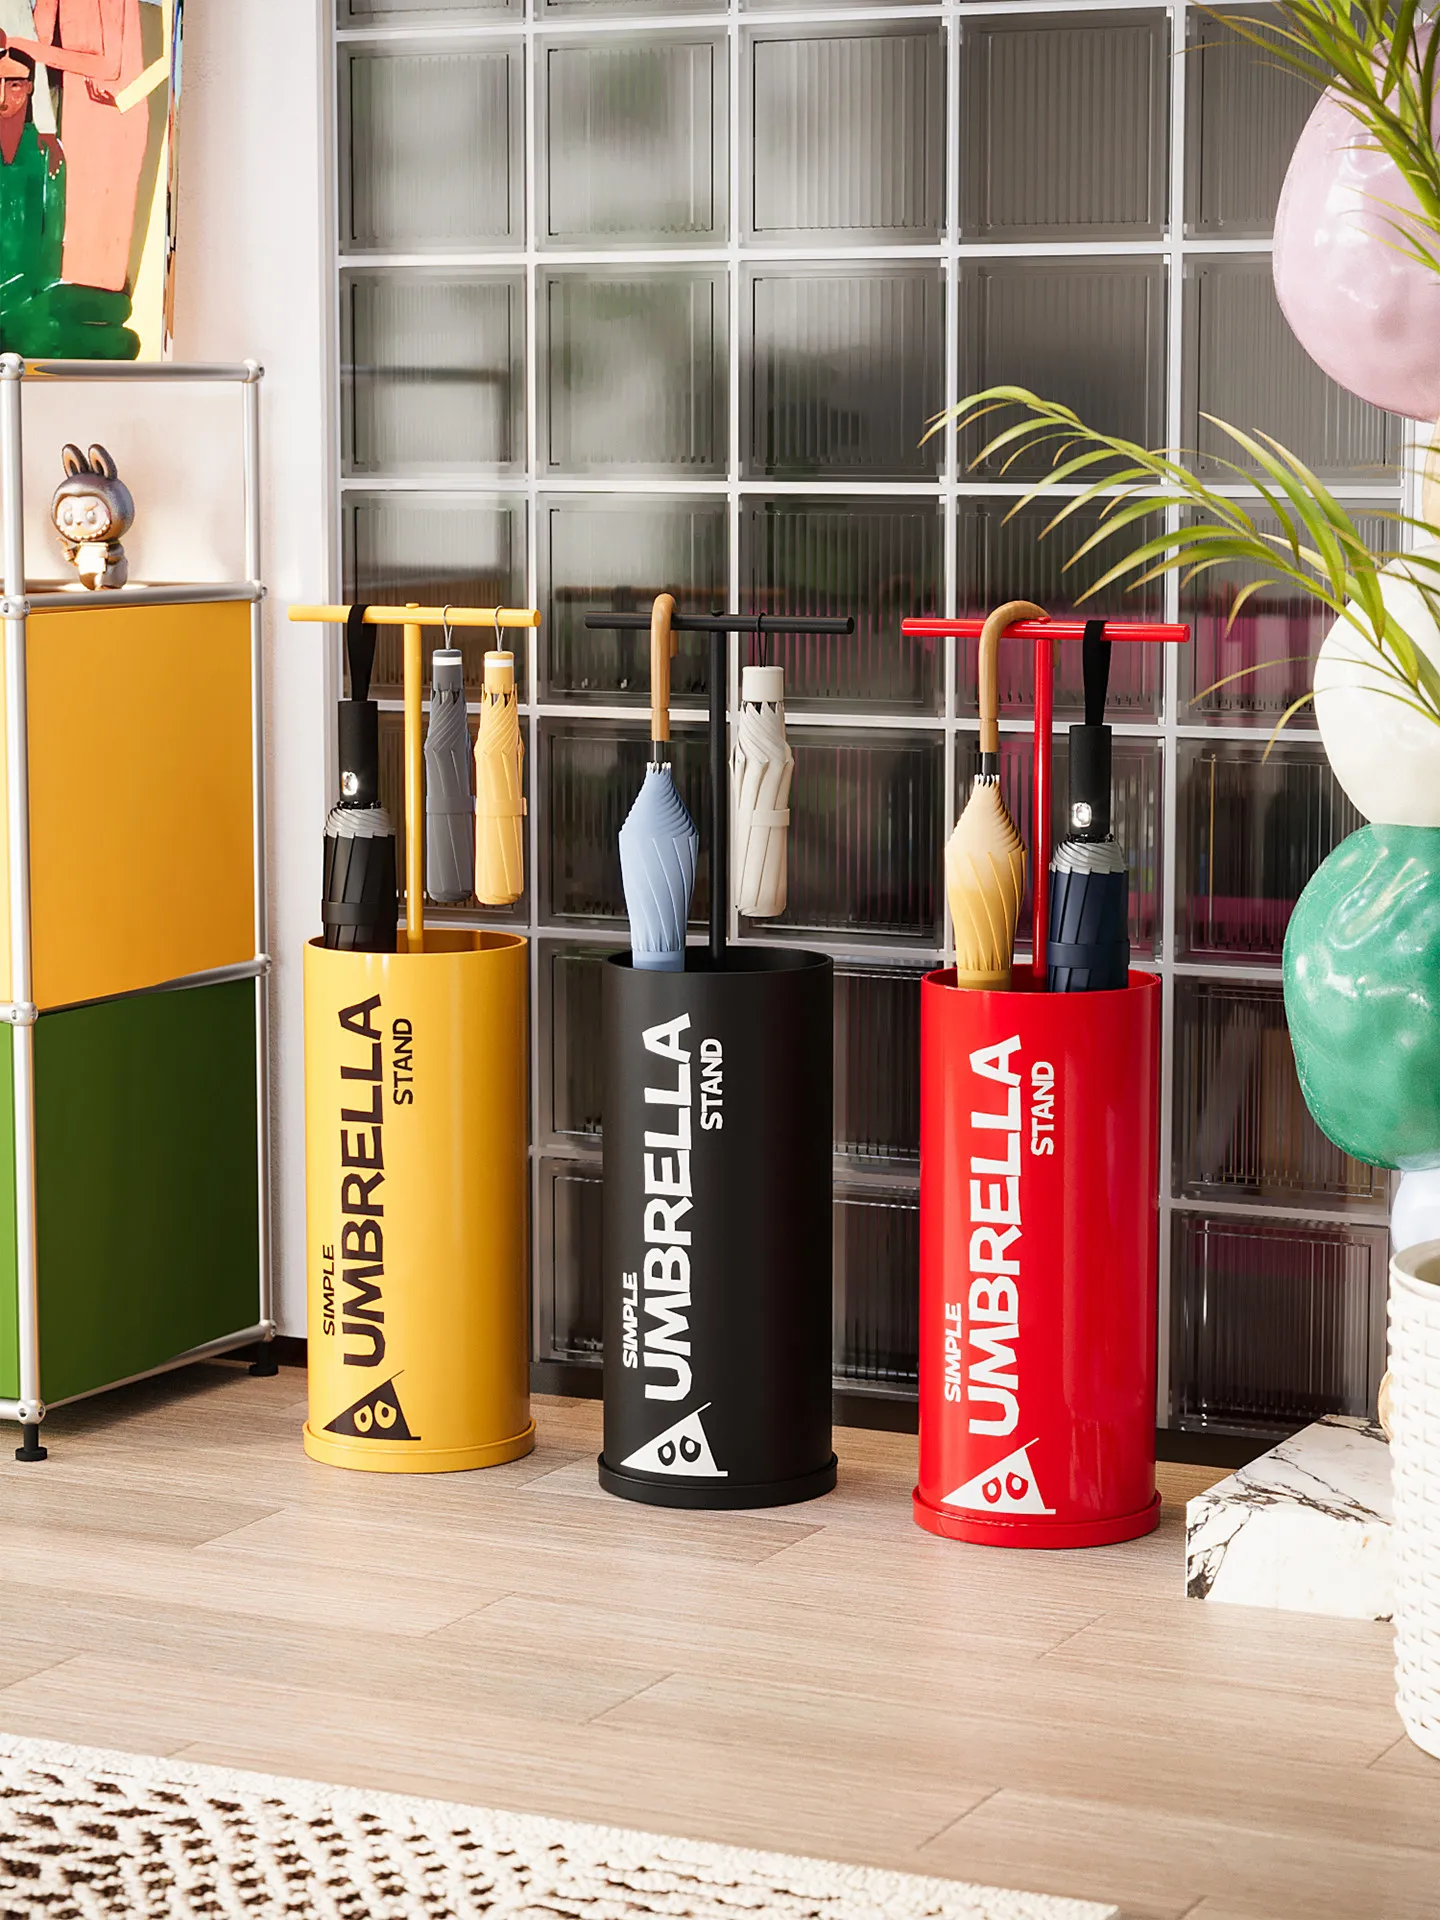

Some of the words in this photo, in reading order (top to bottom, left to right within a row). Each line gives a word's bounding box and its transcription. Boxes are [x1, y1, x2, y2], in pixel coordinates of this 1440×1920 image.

[392, 1017, 414, 1106] STAND
[700, 1037, 723, 1130] STAND
[1030, 1060, 1056, 1156] STAND
[338, 993, 387, 1368] UMBRELLA
[641, 1012, 694, 1402] UMBRELLA
[967, 1034, 1024, 1437] UMBRELLA
[322, 1244, 335, 1337] SIMPLE
[622, 1271, 639, 1369] SIMPLE
[944, 1302, 962, 1403] SIMPLE
